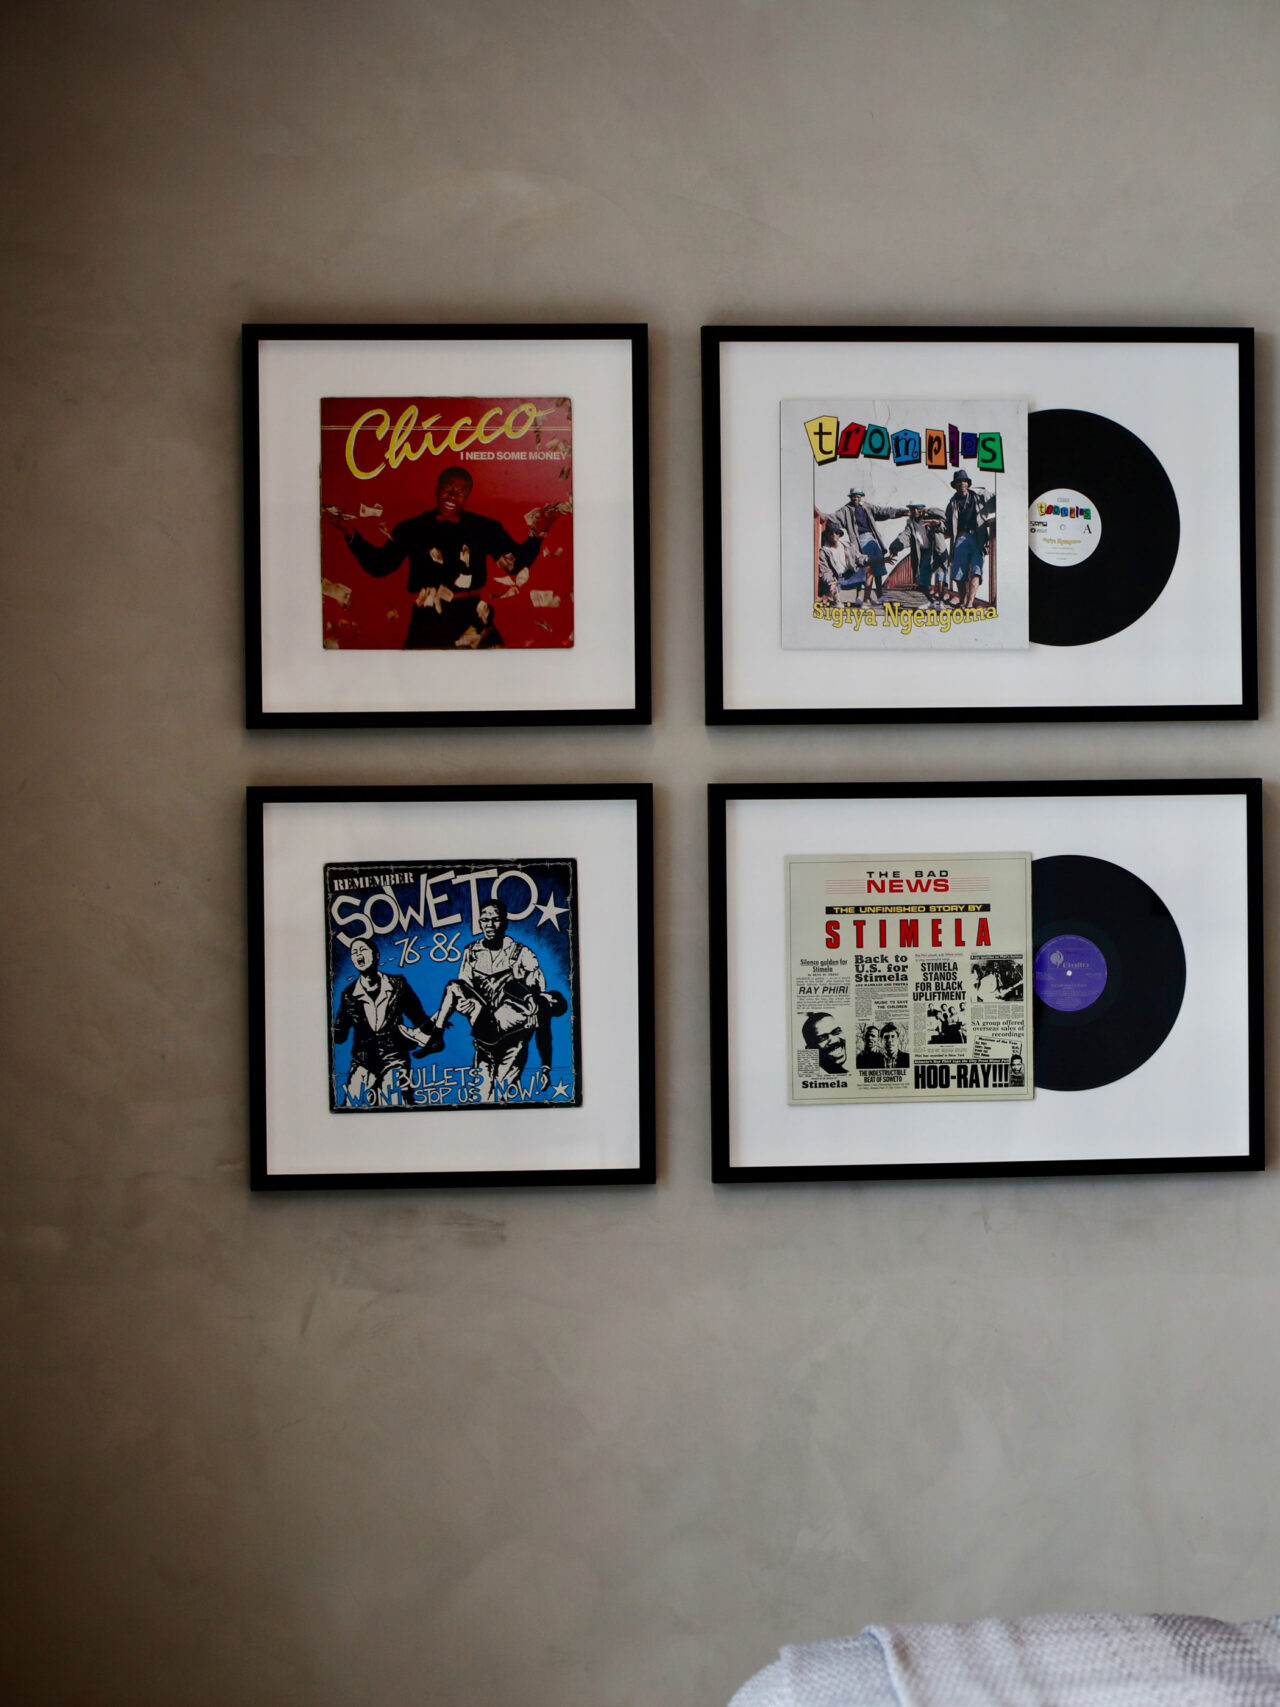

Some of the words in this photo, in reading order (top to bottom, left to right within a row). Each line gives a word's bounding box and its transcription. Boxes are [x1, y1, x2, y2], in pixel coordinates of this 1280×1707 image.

[345, 403, 555, 480] Chicco
[460, 452, 464, 460] I
[465, 451, 495, 460] NEED
[496, 451, 527, 460] SOME
[528, 451, 568, 460] MONEY
[1083, 524, 1092, 534] A
[813, 601, 878, 631] Sigiya
[882, 601, 999, 635] Ngengoma
[914, 870, 949, 878] BAD
[333, 872, 415, 892] REMEMBER
[866, 878, 949, 893] NEWS
[330, 868, 539, 948] SOWETO
[833, 906, 855, 914] THE
[859, 905, 926, 913] UNFINISHED
[929, 905, 965, 913] STORY
[967, 904, 983, 912] BY
[825, 917, 991, 949] STIMELA
[854, 954, 889, 964] Back
[894, 954, 908, 962] to
[854, 964, 882, 973] U.S.
[886, 963, 909, 972] for
[920, 961, 959, 972] STIMELA
[854, 973, 909, 982] Stimela
[922, 971, 958, 981] STANDS
[798, 986, 820, 994] RAY
[822, 985, 849, 994] PHIRI
[915, 982, 932, 991] FOR
[934, 981, 963, 991] BLACK
[912, 991, 967, 1001] UPLIFTMENT
[391, 1064, 485, 1090] BULLETS
[914, 1063, 1009, 1089] HOO-RAY!!!
[801, 1080, 848, 1089] Stimela
[414, 1087, 452, 1104] STOP
[457, 1086, 483, 1103] US
